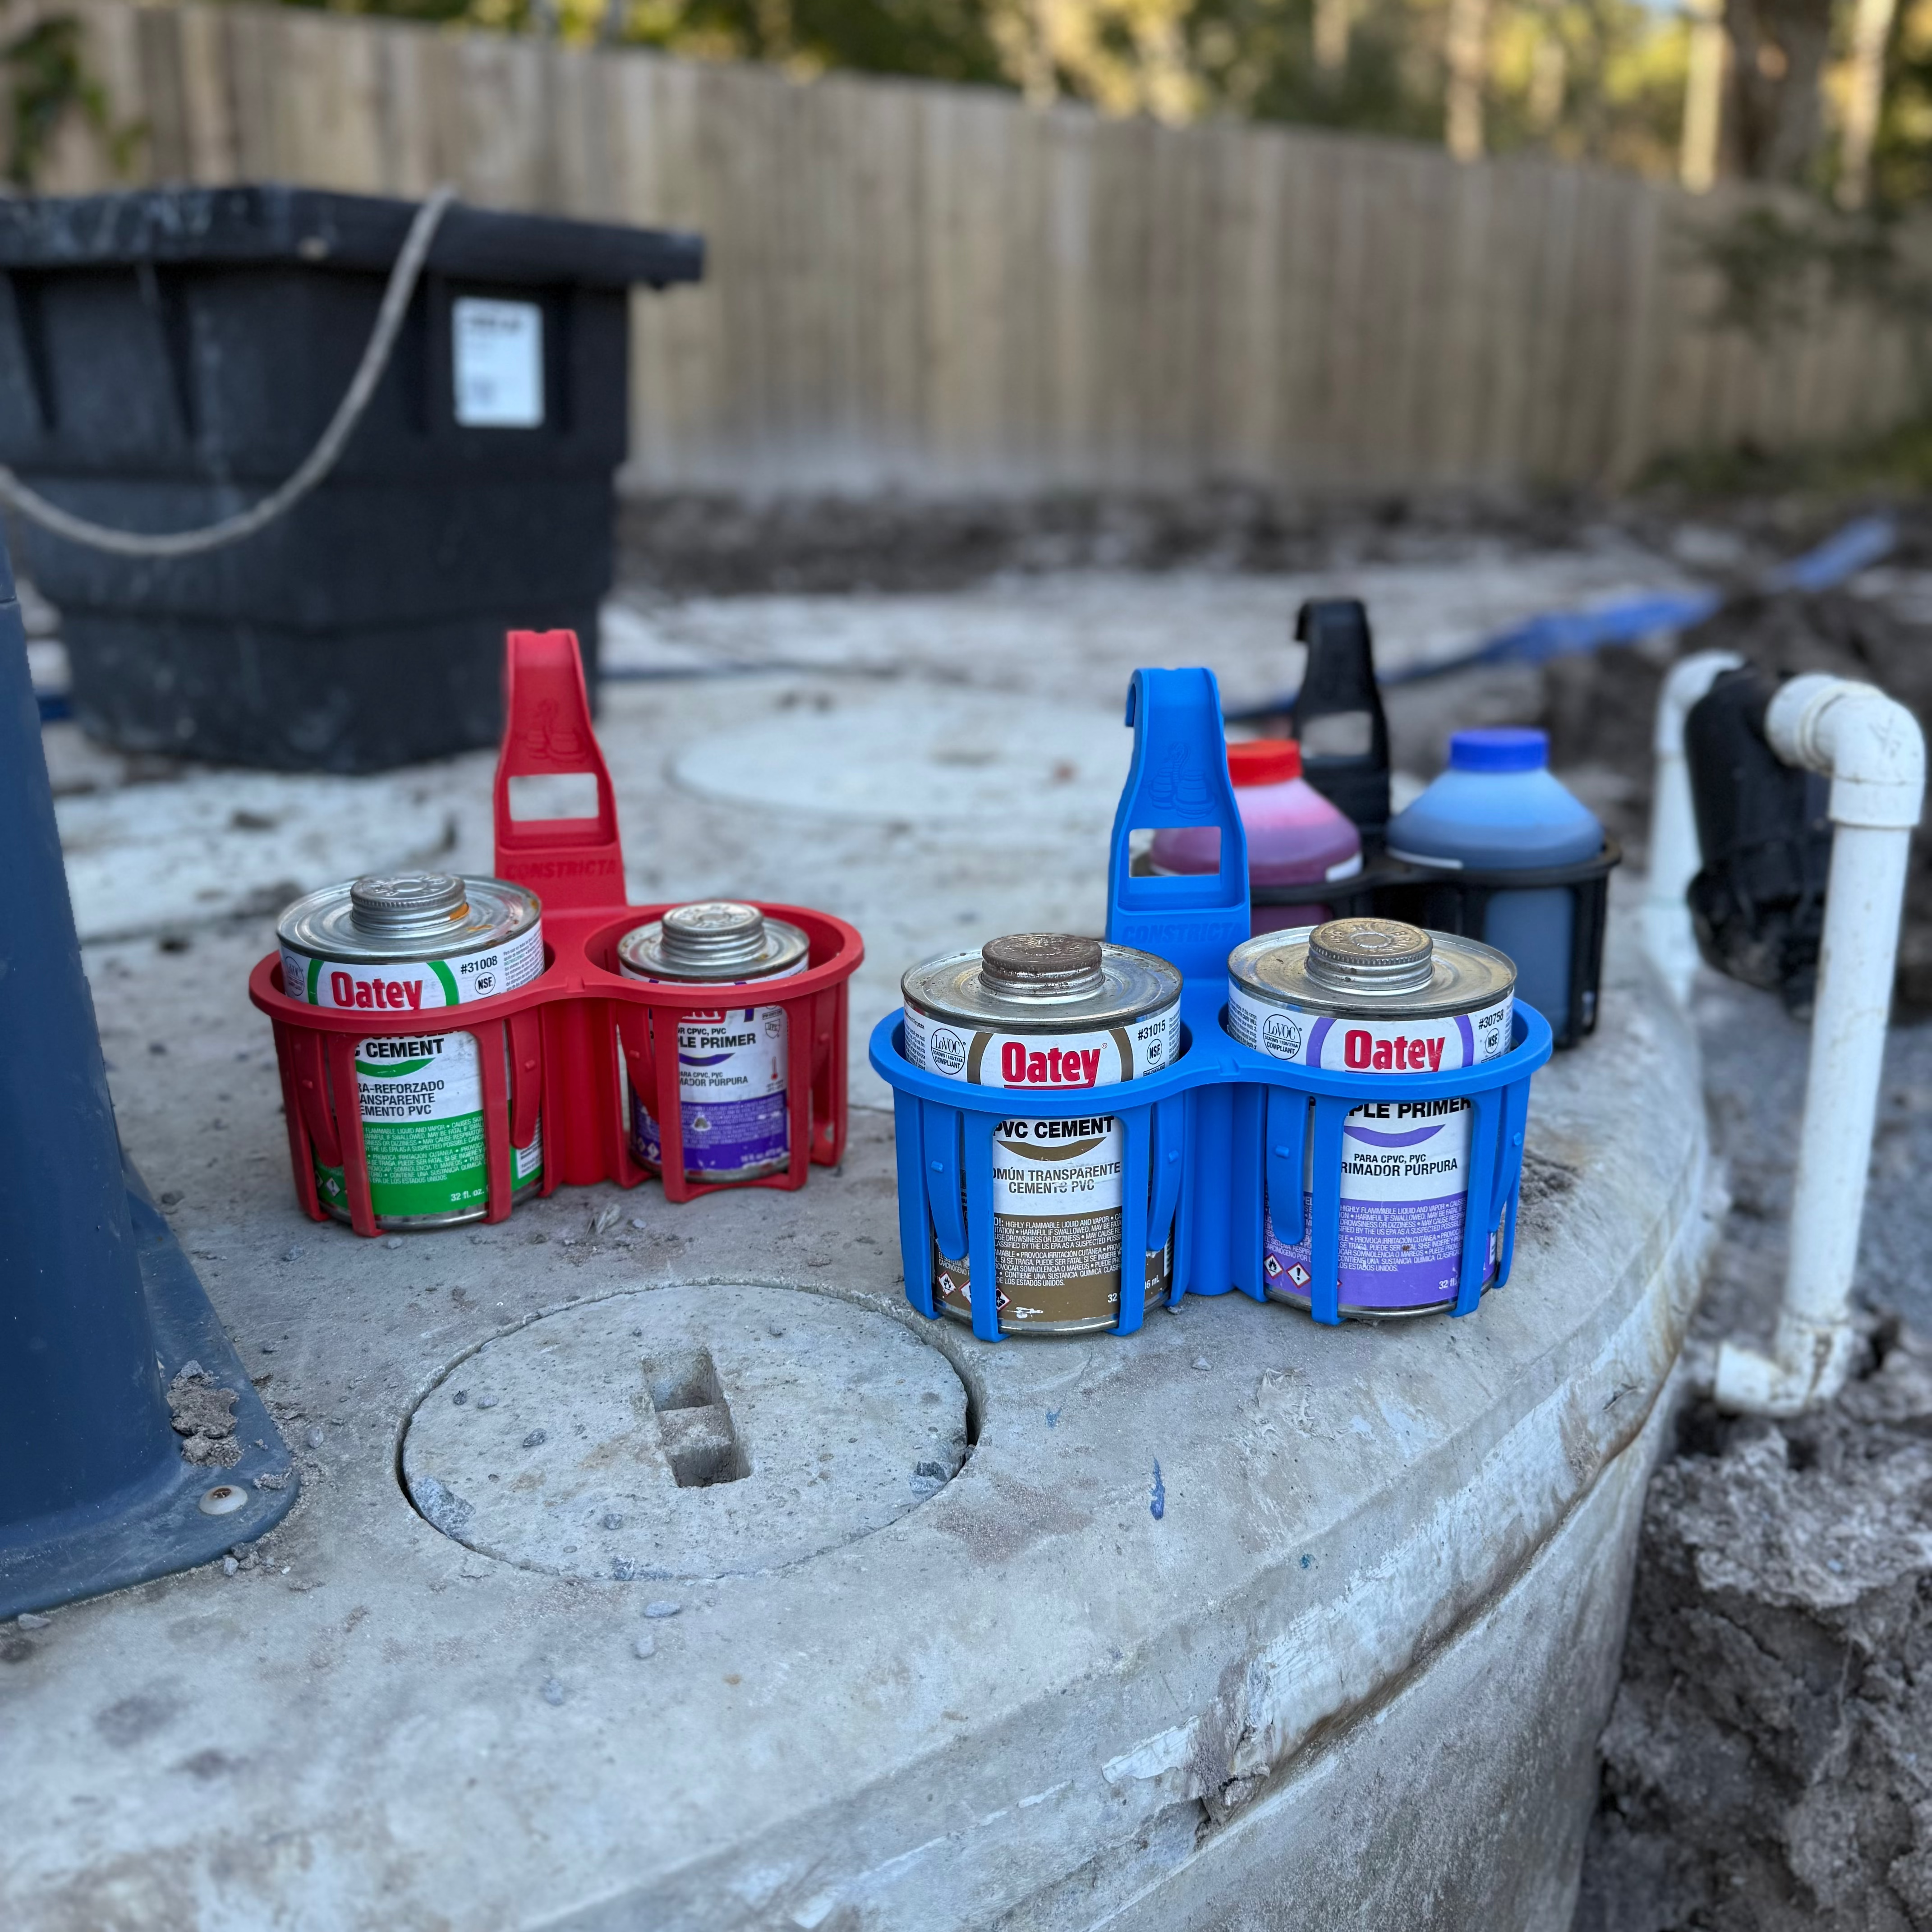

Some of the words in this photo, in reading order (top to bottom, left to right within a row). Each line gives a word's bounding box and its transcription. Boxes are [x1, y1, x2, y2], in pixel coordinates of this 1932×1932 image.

[460, 956, 497, 974] #31008
[331, 971, 423, 1010] Oatey
[687, 1028, 709, 1036] CPVC,
[1138, 1019, 1165, 1041] #31015
[1268, 1020, 1295, 1040] LoVOC
[678, 1036, 696, 1048] LE
[701, 1033, 756, 1049] PRIMER
[935, 1034, 960, 1054] LoVOC
[1267, 1041, 1295, 1054] COMPLIANT
[366, 1038, 444, 1058] CEMENT
[1344, 1030, 1445, 1072] Oatey
[935, 1056, 960, 1069] COMPLIANT
[1002, 1042, 1100, 1087] Oatey
[709, 1076, 748, 1086] PURPURA
[408, 1104, 432, 1116] PVC
[1348, 1104, 1389, 1119] PLE
[1397, 1097, 1471, 1118] PRIMER
[993, 1121, 1028, 1138] PVC
[1034, 1115, 1114, 1138] CEMENT
[1354, 1153, 1378, 1163] PARA
[1381, 1155, 1406, 1164] CPVC,
[1409, 1154, 1426, 1163] PVC
[1028, 1162, 1121, 1181] TRANSPARENTE
[1405, 1158, 1458, 1176] PURPURA
[1009, 1182, 1067, 1194] CEMENTO
[1072, 1178, 1094, 1192] PVC
[451, 1193, 461, 1202] 32
[463, 1190, 471, 1199] fl.
[474, 1188, 484, 1197] oz.
[1429, 1203, 1445, 1211] VAPOR
[1062, 1220, 1078, 1228] LIQUID
[1092, 1216, 1109, 1224] VAPOR
[1006, 1235, 1042, 1243] DROWSINESS
[1098, 1228, 1114, 1237] CAUSE
[1054, 1226, 1090, 1236] SWALLOWED.
[1075, 1237, 1105, 1248] SUSPECTED
[1048, 1250, 1077, 1258] IRRITACIÓN
[1078, 1247, 1102, 1256] CUTÁNEA
[1067, 1263, 1089, 1271] MAREOS
[1095, 1259, 1111, 1268] PUEDE
[1005, 1271, 1031, 1279] CONTIENE
[1048, 1270, 1078, 1279] SUSTANCIA
[1080, 1268, 1102, 1277] QUIMICA
[1152, 1275, 1159, 1286] mL
[1439, 1280, 1448, 1289] 32
[1108, 1293, 1118, 1303] 32
